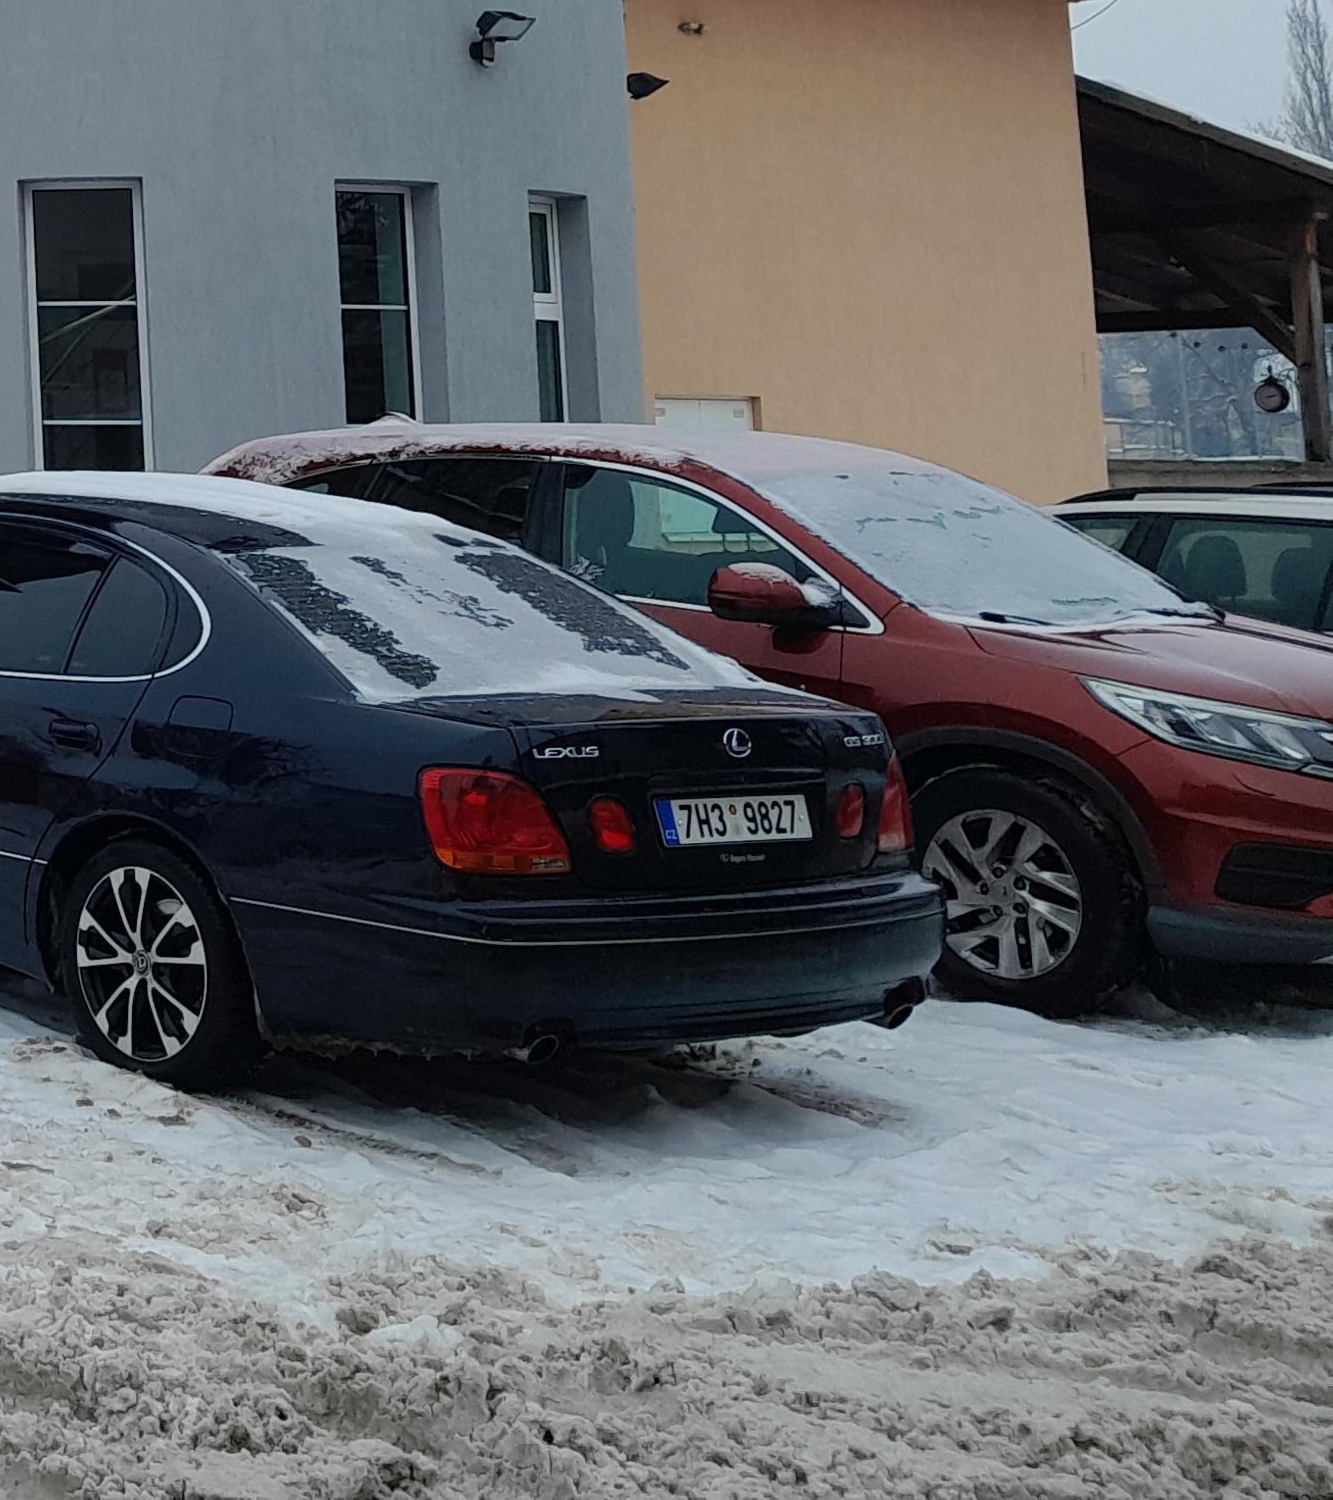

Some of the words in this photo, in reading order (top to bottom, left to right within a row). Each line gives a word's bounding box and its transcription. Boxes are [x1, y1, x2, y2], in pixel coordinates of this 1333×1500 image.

[532, 746, 600, 759] LEXUS
[678, 803, 727, 839] 7H3
[743, 800, 796, 835] 9827
